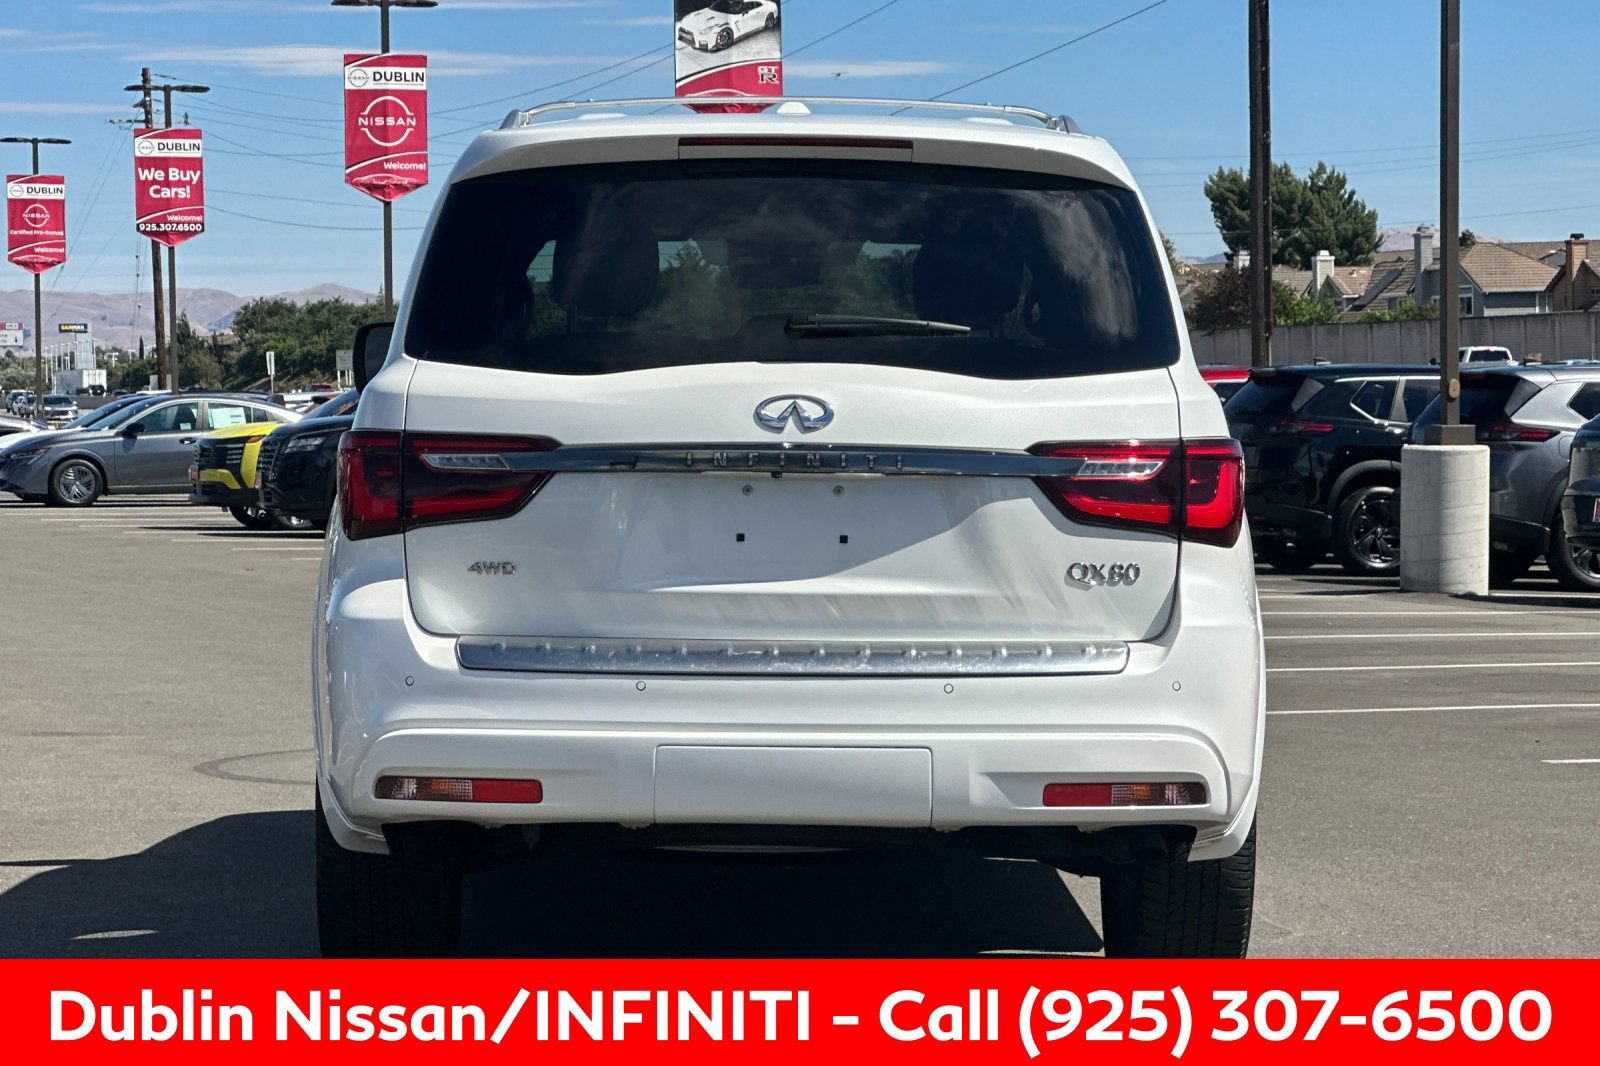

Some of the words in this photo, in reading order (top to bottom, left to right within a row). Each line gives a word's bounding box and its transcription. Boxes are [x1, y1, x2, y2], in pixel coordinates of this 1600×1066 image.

[373, 71, 424, 82] DUBLIN
[358, 117, 416, 126] NISSAN
[157, 142, 200, 151] DUBLIN
[383, 161, 426, 170] Welcome!
[138, 168, 164, 180] We
[169, 168, 200, 184] Buy
[26, 186, 63, 195] DUBLIN
[149, 185, 190, 198] Cars!
[139, 223, 202, 231] 925.307.6500
[686, 452, 903, 470] INFINITI
[467, 561, 517, 575] 4WD
[1066, 562, 1141, 586] QX80
